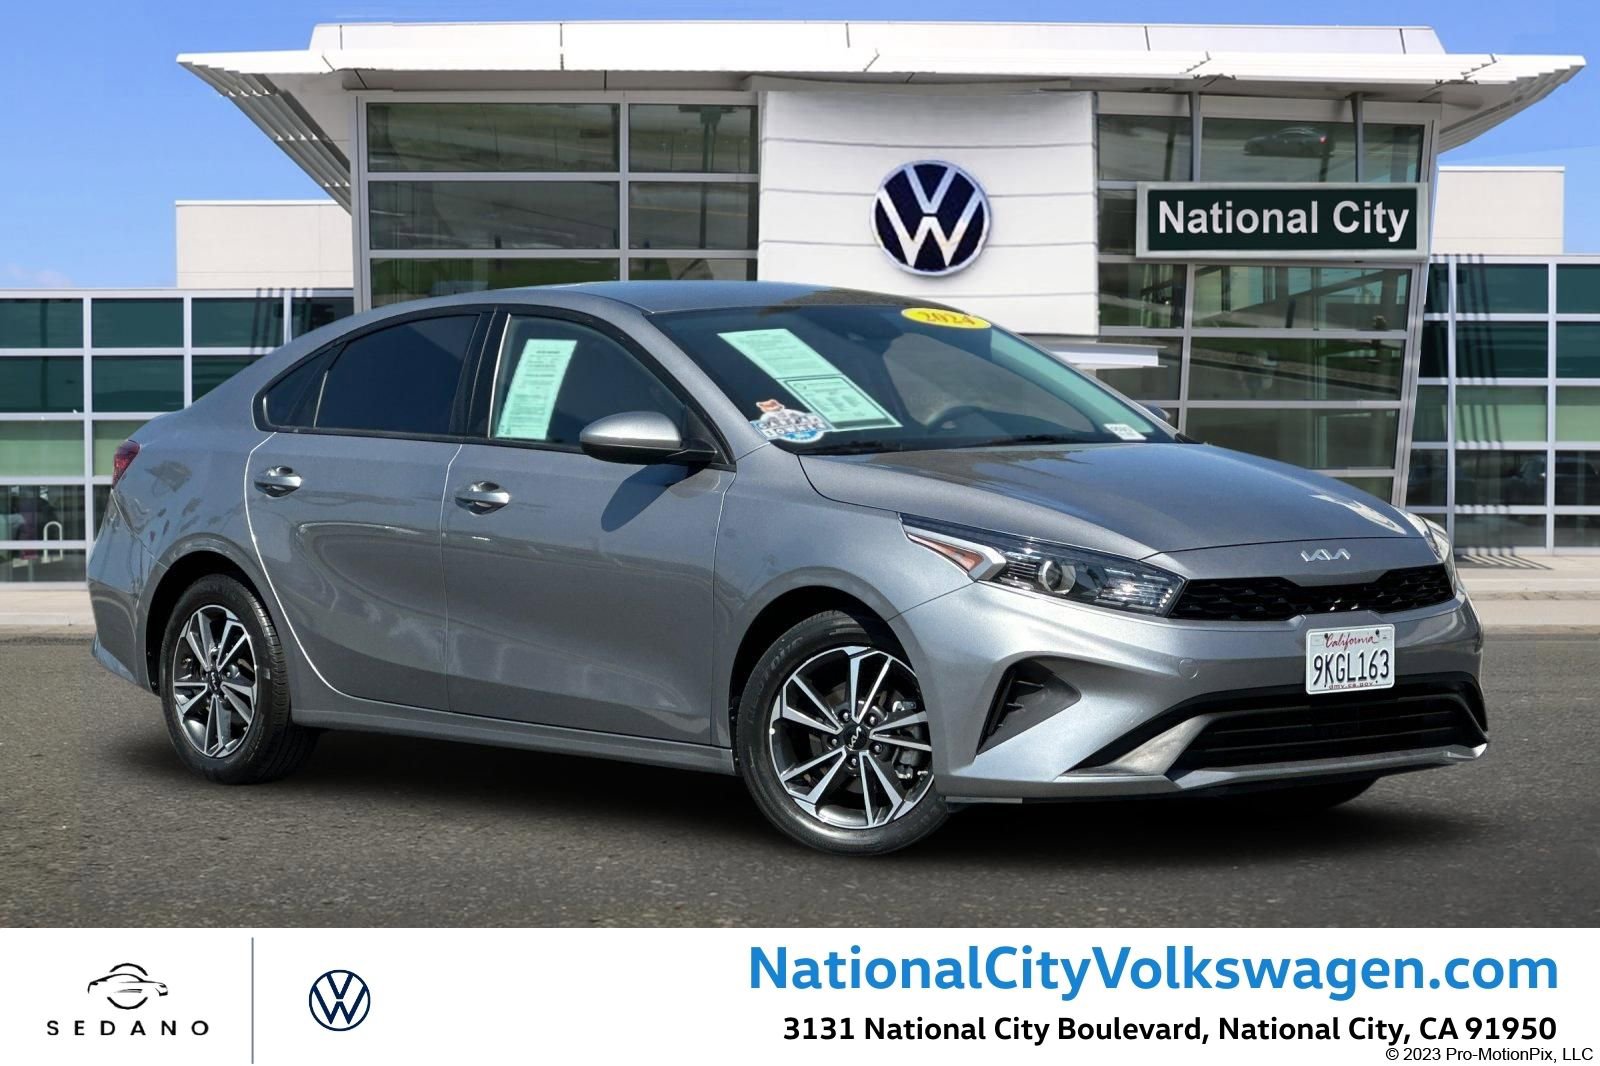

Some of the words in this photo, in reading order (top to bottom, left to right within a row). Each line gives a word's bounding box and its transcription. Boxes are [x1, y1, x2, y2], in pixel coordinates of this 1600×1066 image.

[870, 160, 991, 276] VW
[1159, 201, 1317, 234] National
[1332, 201, 1410, 242] City
[917, 311, 976, 325] 2024
[1325, 632, 1377, 651] California
[1313, 649, 1390, 686] 9KGL163
[1328, 681, 1374, 690] dmv.ca.gov
